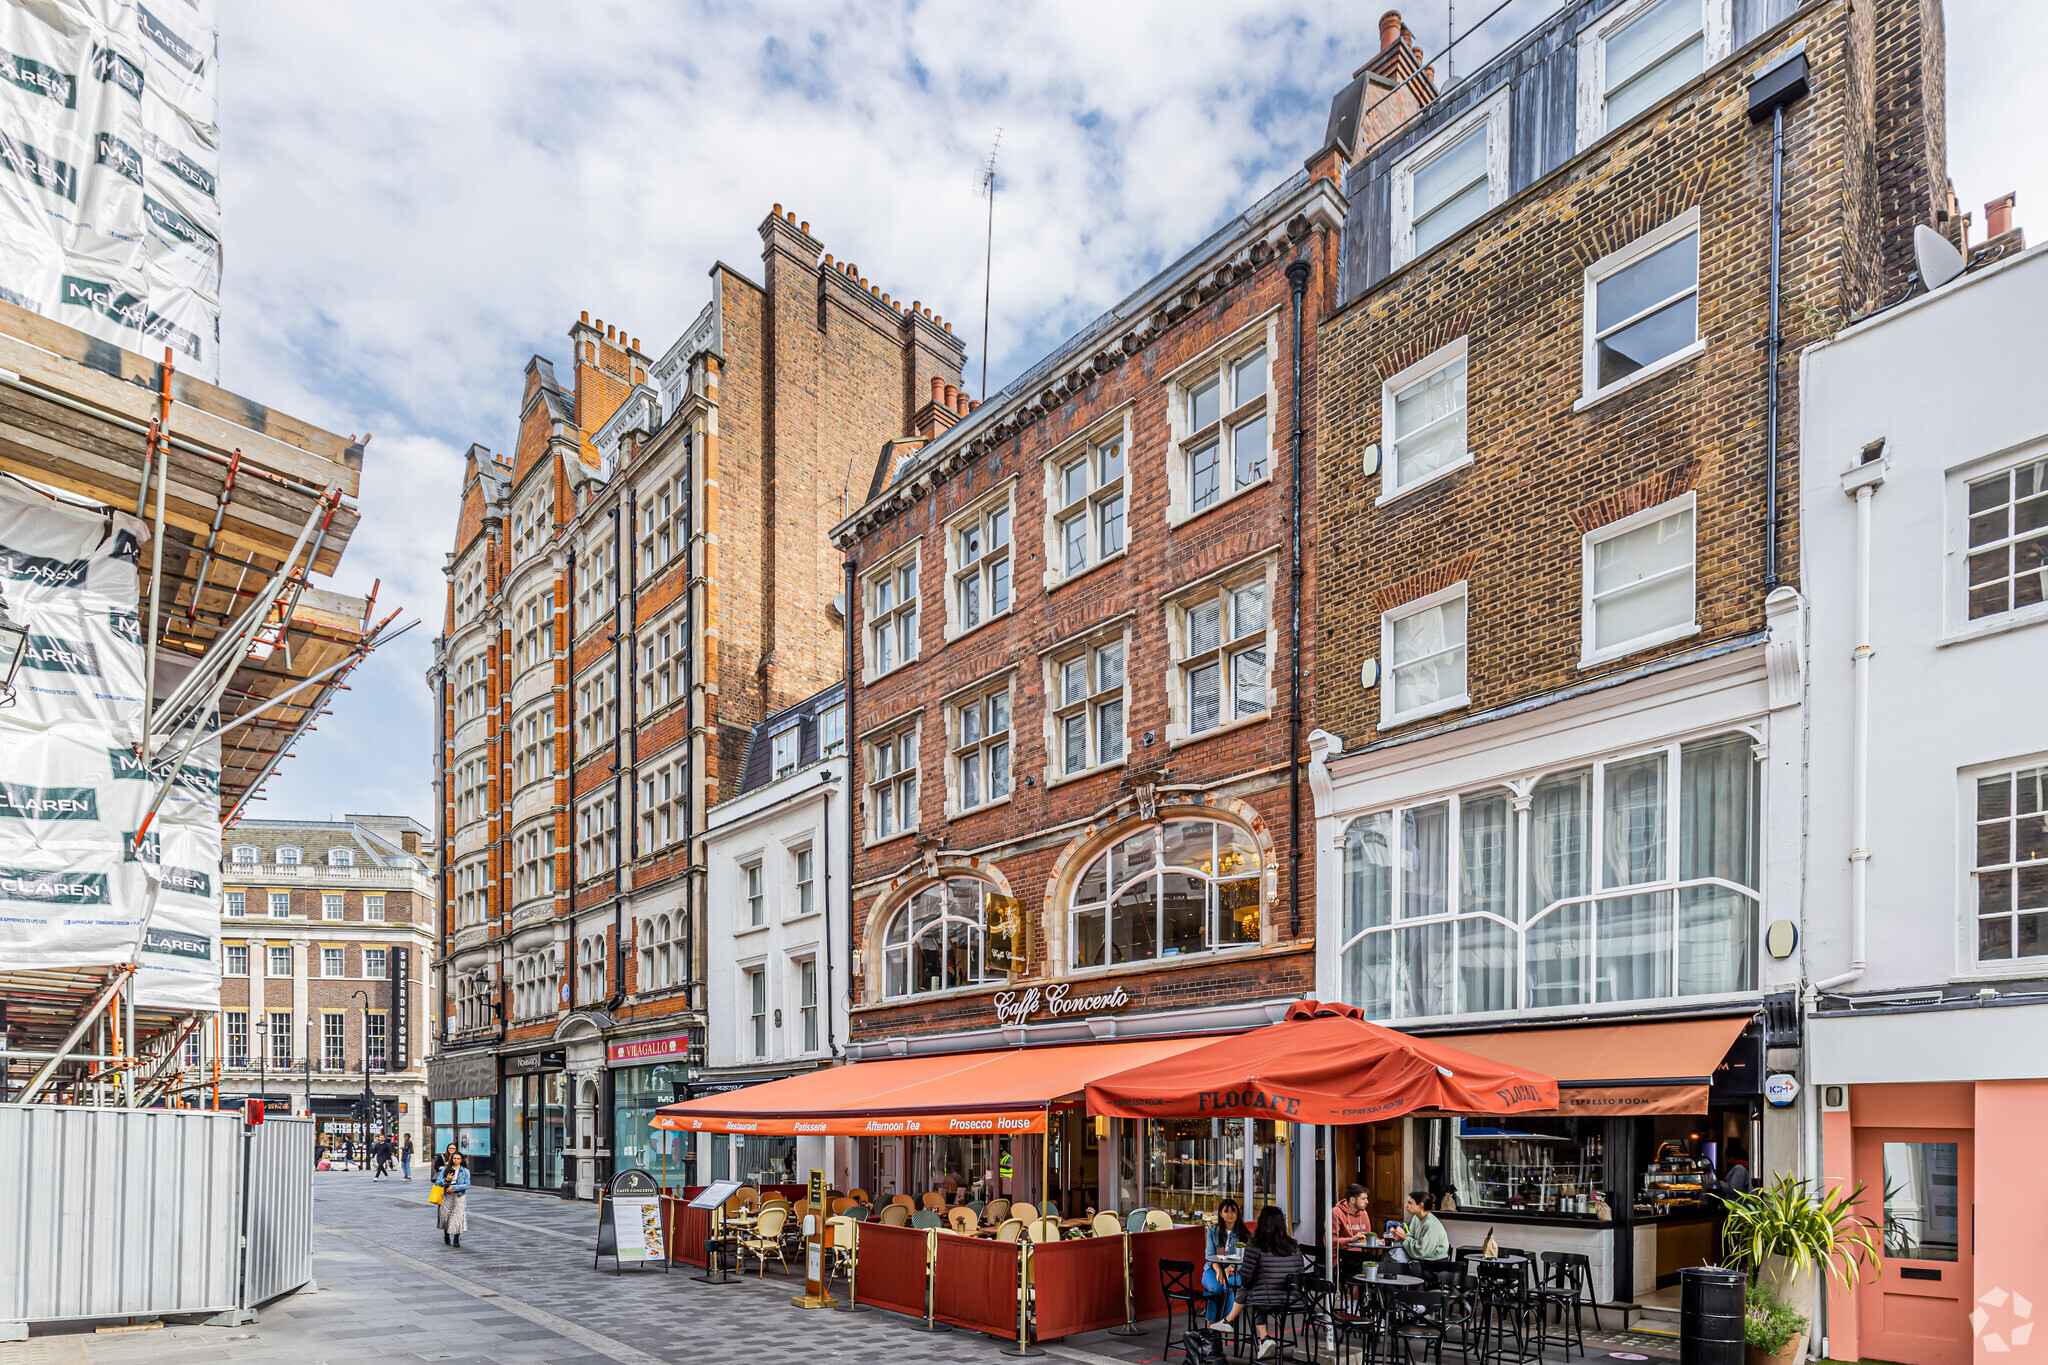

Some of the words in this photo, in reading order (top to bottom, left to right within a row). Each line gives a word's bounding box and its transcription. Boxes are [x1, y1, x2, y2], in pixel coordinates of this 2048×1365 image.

[1045, 983, 1129, 1017] Concerto
[626, 1041, 668, 1057] VILAGALLO
[1769, 1085, 1789, 1094] ICM
[1114, 1098, 1144, 1107] ESPRESSO
[1144, 1098, 1163, 1106] ROOM
[1197, 1089, 1301, 1116] FLOCAFE
[1342, 1105, 1382, 1116] ESPRESSO
[1383, 1099, 1404, 1111] ROOM
[1570, 1098, 1616, 1106] ESPRESSO
[1618, 1097, 1650, 1105] ROOM
[692, 1119, 703, 1129] Bar
[725, 1121, 758, 1131] Restaurant
[793, 1121, 827, 1132] Patisserie
[865, 1120, 904, 1132] Afternoon
[906, 1120, 920, 1131] Tea
[949, 1118, 993, 1130] Prosecco
[997, 1116, 1031, 1129] House
